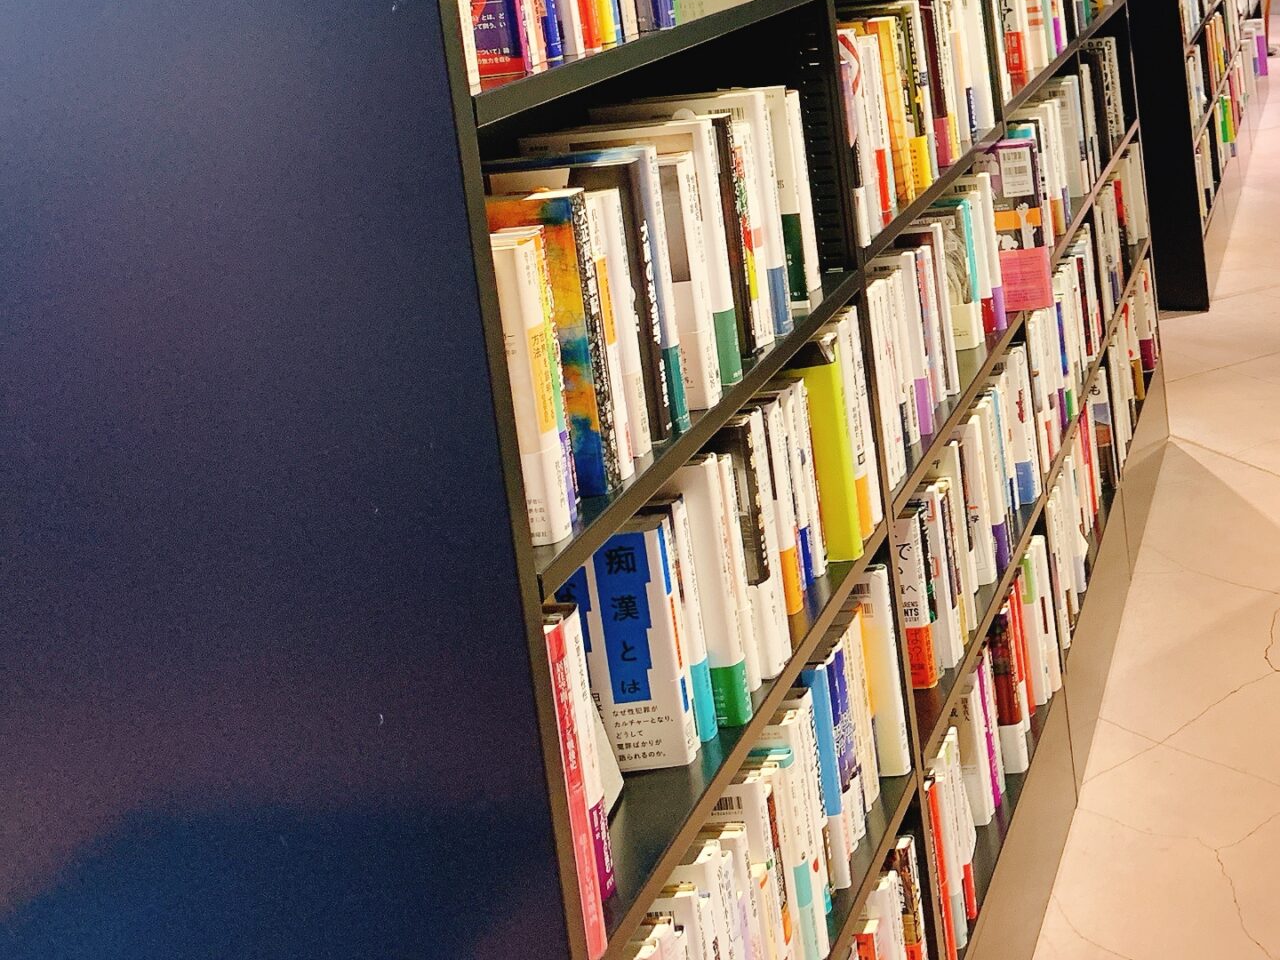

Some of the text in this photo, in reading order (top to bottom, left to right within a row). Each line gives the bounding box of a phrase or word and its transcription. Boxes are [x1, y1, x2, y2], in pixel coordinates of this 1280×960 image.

[604, 546, 643, 696] 痴漢とは
[611, 704, 660, 718] なぜ性犯罪が
[613, 716, 676, 729] カルチャーとなり、
[616, 728, 645, 740] どうして
[618, 750, 668, 763] 語られるのか。
